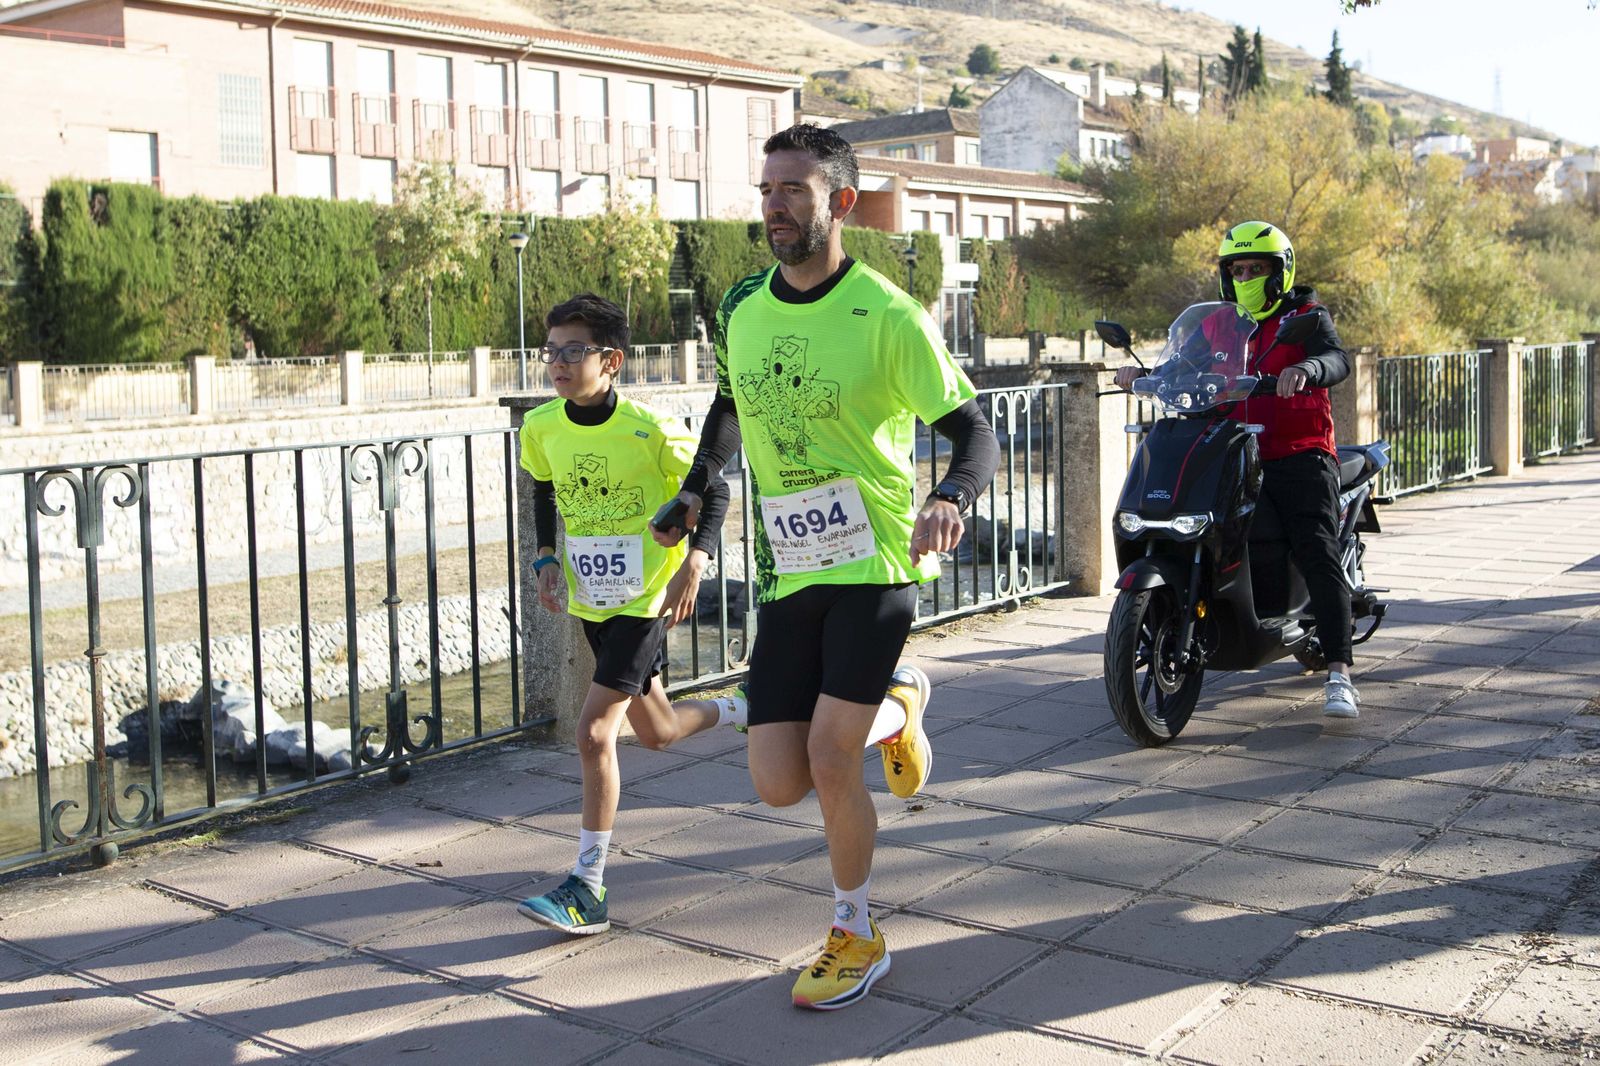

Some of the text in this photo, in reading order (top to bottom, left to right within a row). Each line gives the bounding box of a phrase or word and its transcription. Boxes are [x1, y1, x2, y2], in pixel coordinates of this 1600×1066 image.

[779, 468, 816, 478] carrera
[782, 470, 841, 488] cruzroja.es
[774, 501, 848, 539] 1694
[572, 553, 626, 577] 1695
